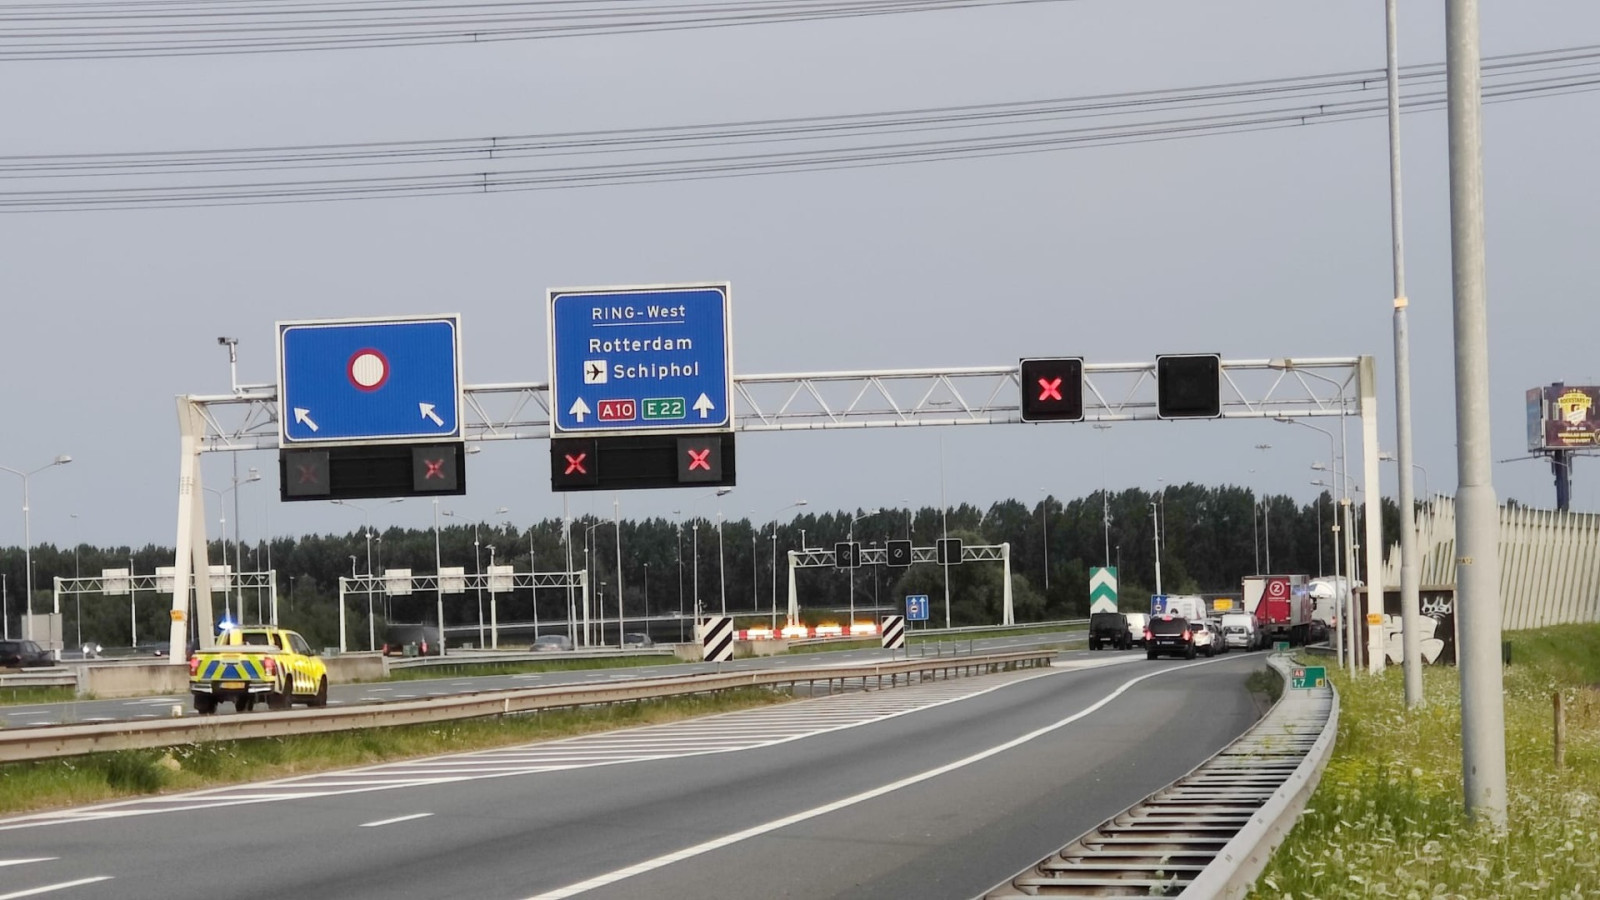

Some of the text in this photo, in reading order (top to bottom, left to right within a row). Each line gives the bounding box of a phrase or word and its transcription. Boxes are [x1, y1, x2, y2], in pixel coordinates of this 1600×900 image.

[592, 304, 685, 320] RING-West
[589, 336, 692, 353] Rotterdam
[613, 361, 699, 380] Schiphol
[602, 403, 633, 417] A10
[1273, 584, 1281, 593] Z
